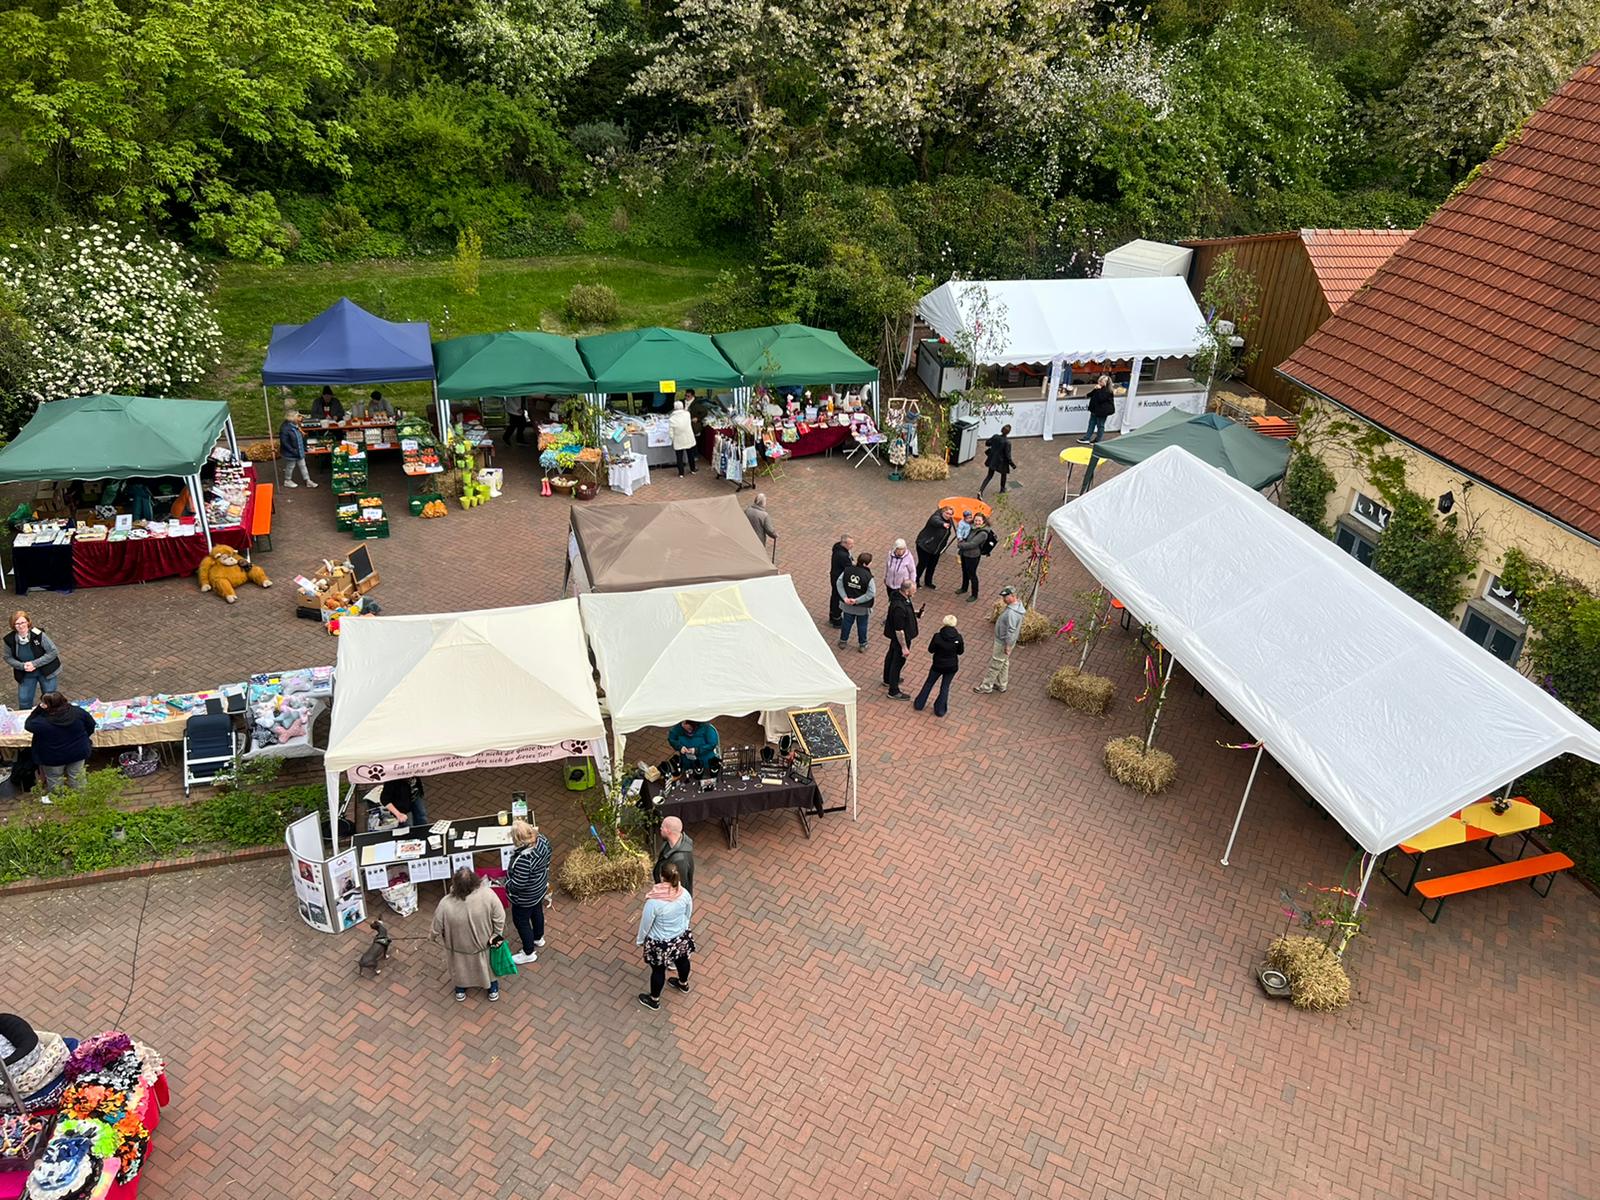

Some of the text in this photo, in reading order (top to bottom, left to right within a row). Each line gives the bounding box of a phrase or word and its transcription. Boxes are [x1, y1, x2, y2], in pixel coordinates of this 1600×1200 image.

[1064, 404, 1089, 412] Krombach
[1143, 400, 1172, 408] Krombacher
[537, 750, 552, 758] Tier!
[393, 763, 404, 771] Ein
